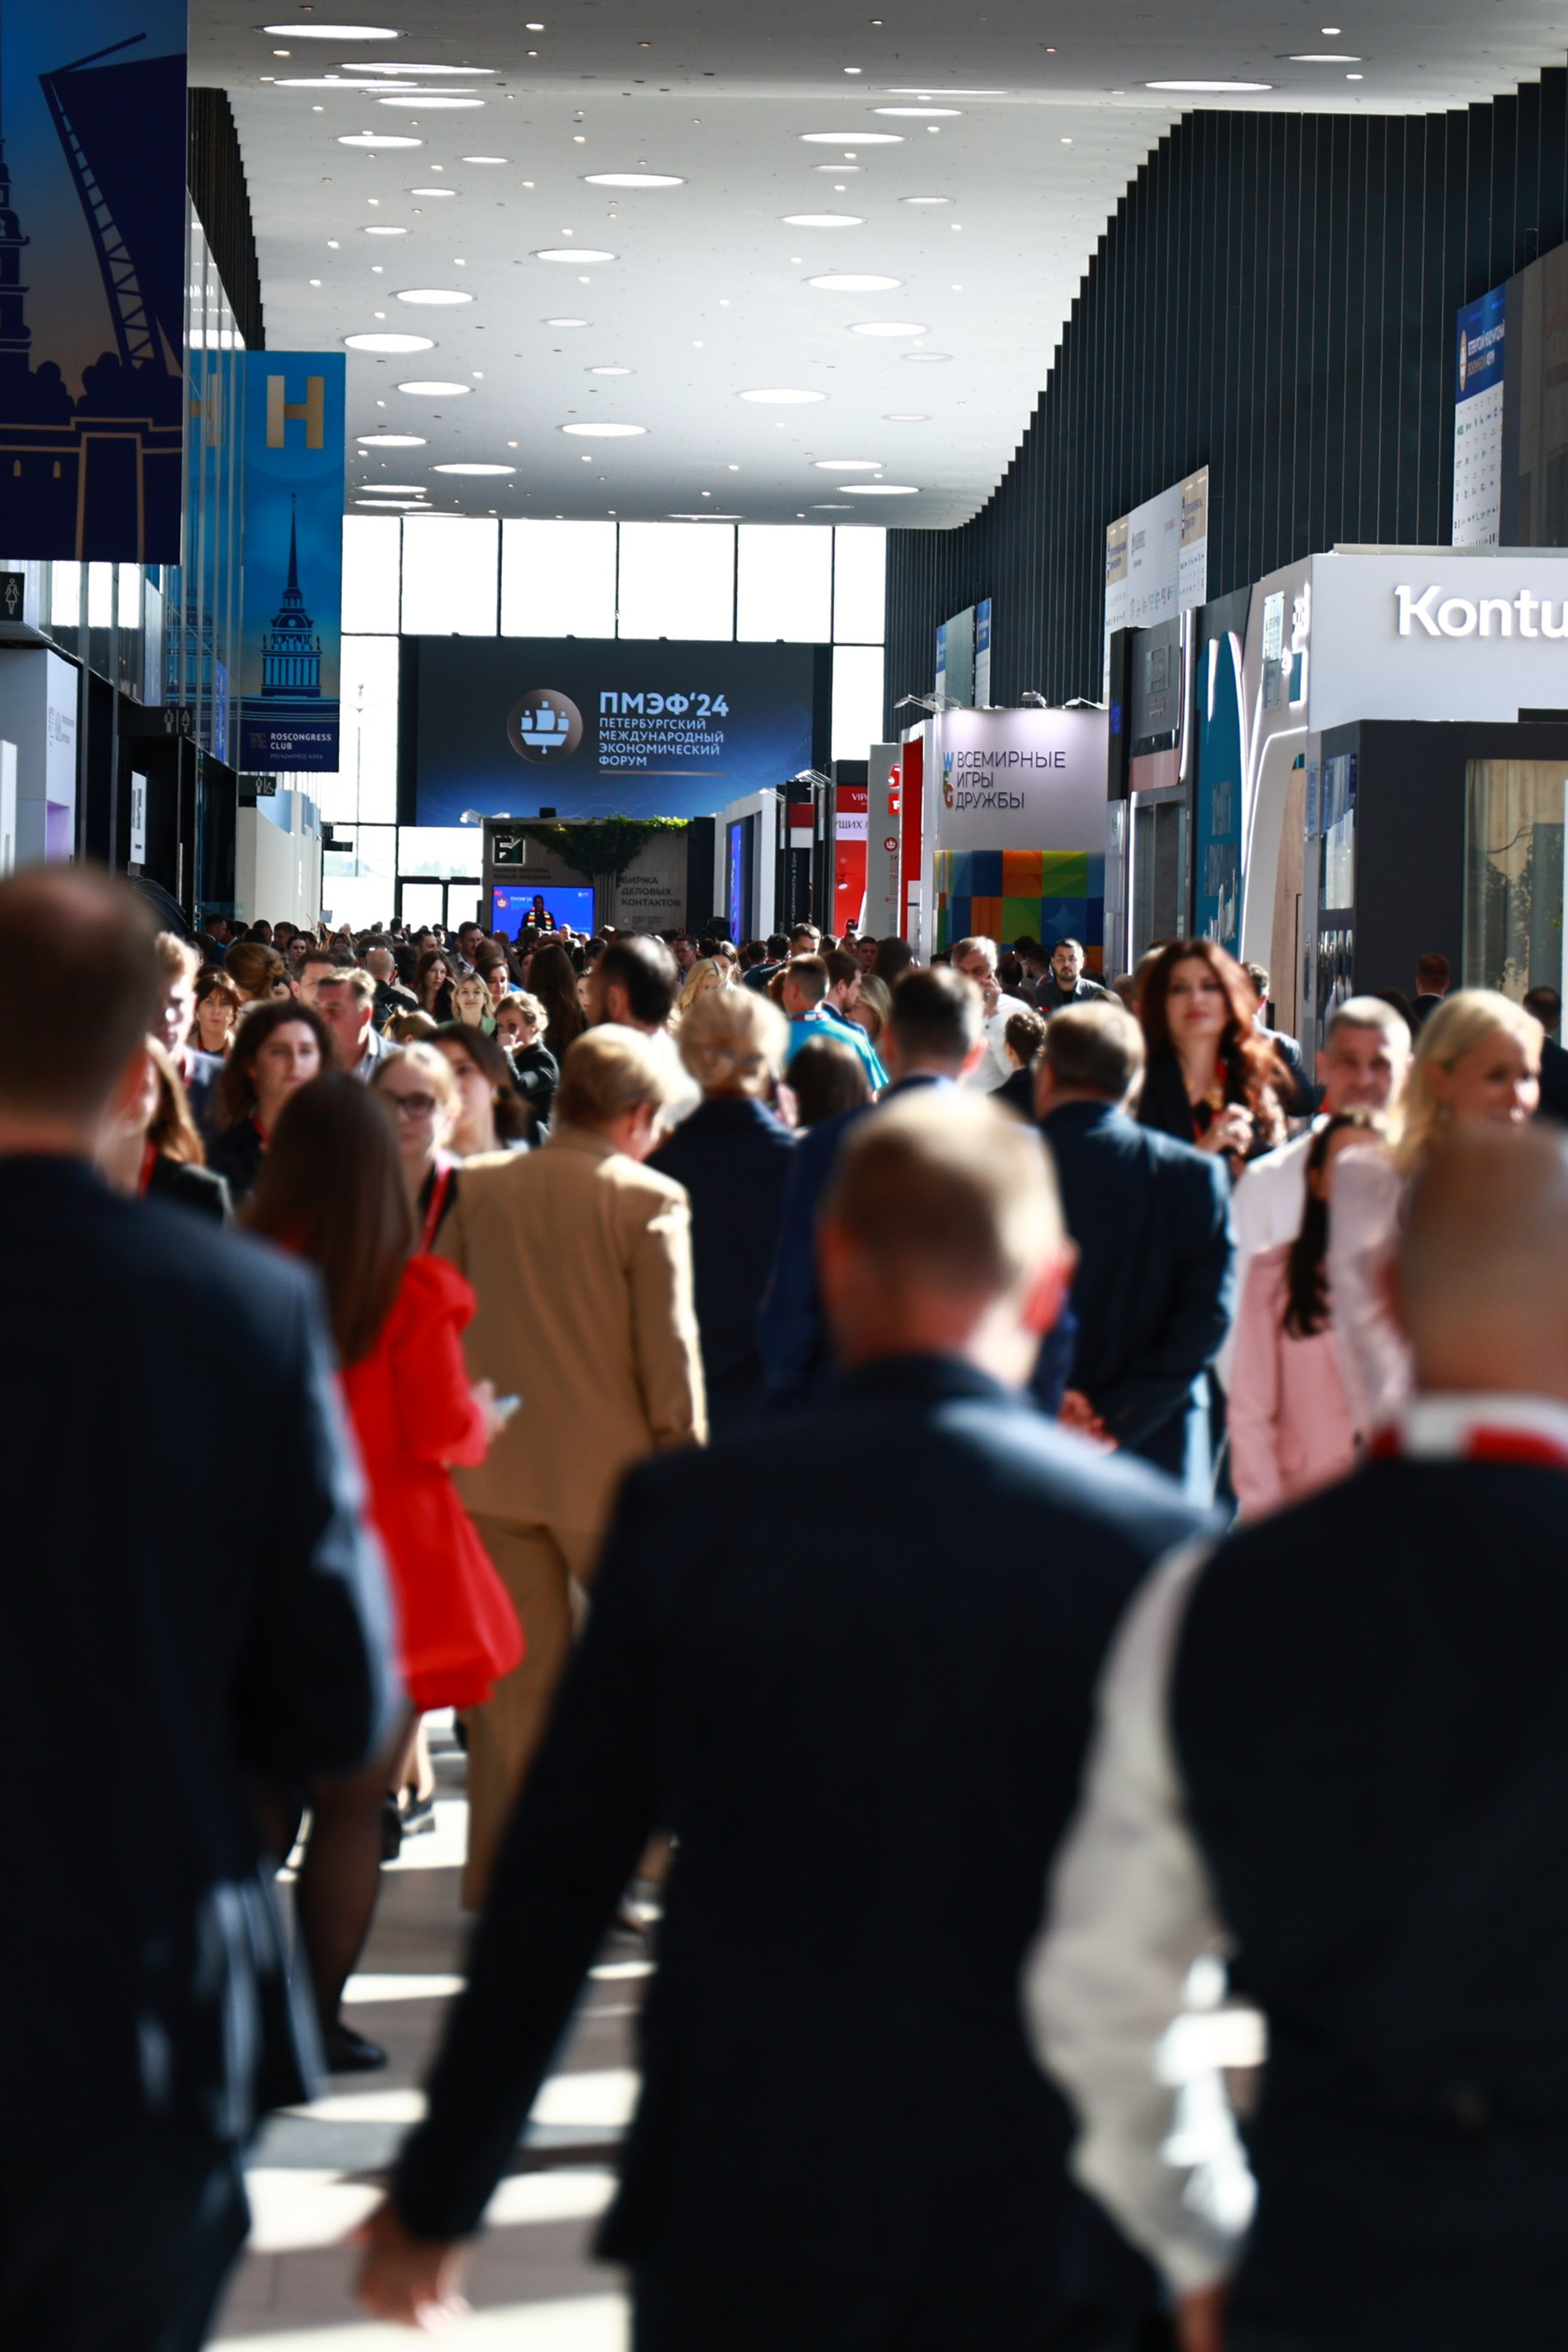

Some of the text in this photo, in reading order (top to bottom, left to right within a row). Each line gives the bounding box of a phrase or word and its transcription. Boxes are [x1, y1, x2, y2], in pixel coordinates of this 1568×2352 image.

[600, 692, 729, 717] ПМЭФ'24
[599, 718, 706, 729] ПЕТЕРБУРГСКИЙ
[599, 731, 724, 743] МЕЖДУНАРОДНЫЙ
[599, 743, 720, 755] ЭКОНОМИЧЕСКИЙ
[599, 755, 647, 766] ФОРУМ
[957, 751, 1066, 768] ВСЕМИРНЫЕ
[957, 772, 993, 788] ИГРЫ
[956, 792, 1024, 811] ДРУЖБЫ
